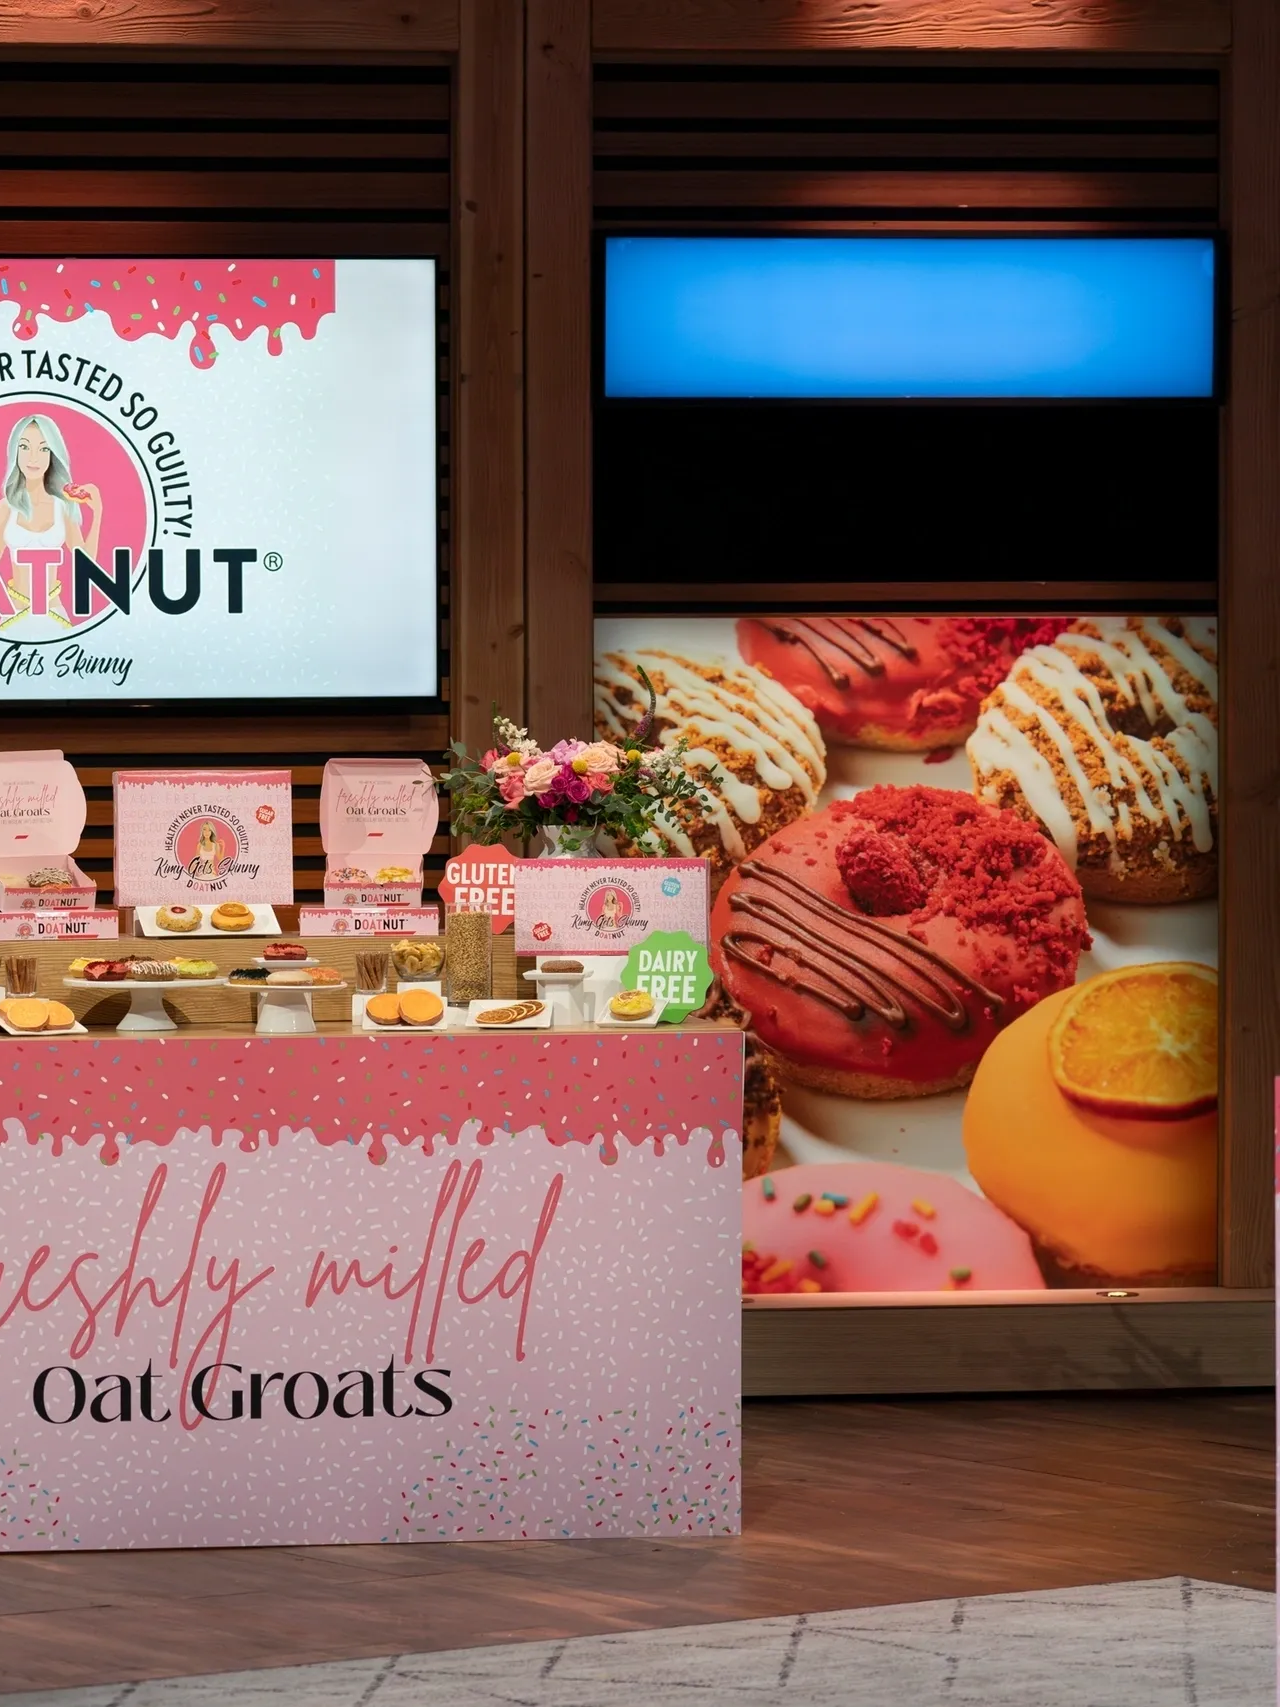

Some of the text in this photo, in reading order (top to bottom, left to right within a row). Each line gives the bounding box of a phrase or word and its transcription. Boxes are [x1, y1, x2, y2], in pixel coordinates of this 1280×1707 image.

[21, 350, 123, 402] TASTED
[120, 392, 158, 431] SO
[148, 431, 193, 538] GUILTY!
[54, 643, 133, 687] Skinny
[13, 808, 51, 817] Groats
[259, 807, 276, 817] SUGAR
[259, 813, 272, 823] FREE
[346, 806, 407, 815] Oat Groats
[165, 818, 182, 851] HEALTHY
[179, 804, 203, 821] NEVER
[204, 804, 231, 818] TASTED
[229, 815, 240, 826] SO
[237, 825, 250, 854] GUILTY!
[154, 857, 184, 881] Kimy
[188, 856, 213, 879] Gets
[218, 857, 260, 880] Skinny
[186, 879, 228, 892] DOATNUT
[579, 887, 590, 911] HEALTHY
[589, 877, 607, 890] NEVER
[608, 876, 628, 888] TASTED
[664, 885, 677, 894] FREE
[454, 886, 515, 915] FREE
[594, 930, 626, 940] DOATNUT
[638, 950, 698, 973] DAIRY
[636, 975, 697, 1004] FREE
[305, 1158, 563, 1365] milled
[32, 1353, 453, 1425] Oat Groats
